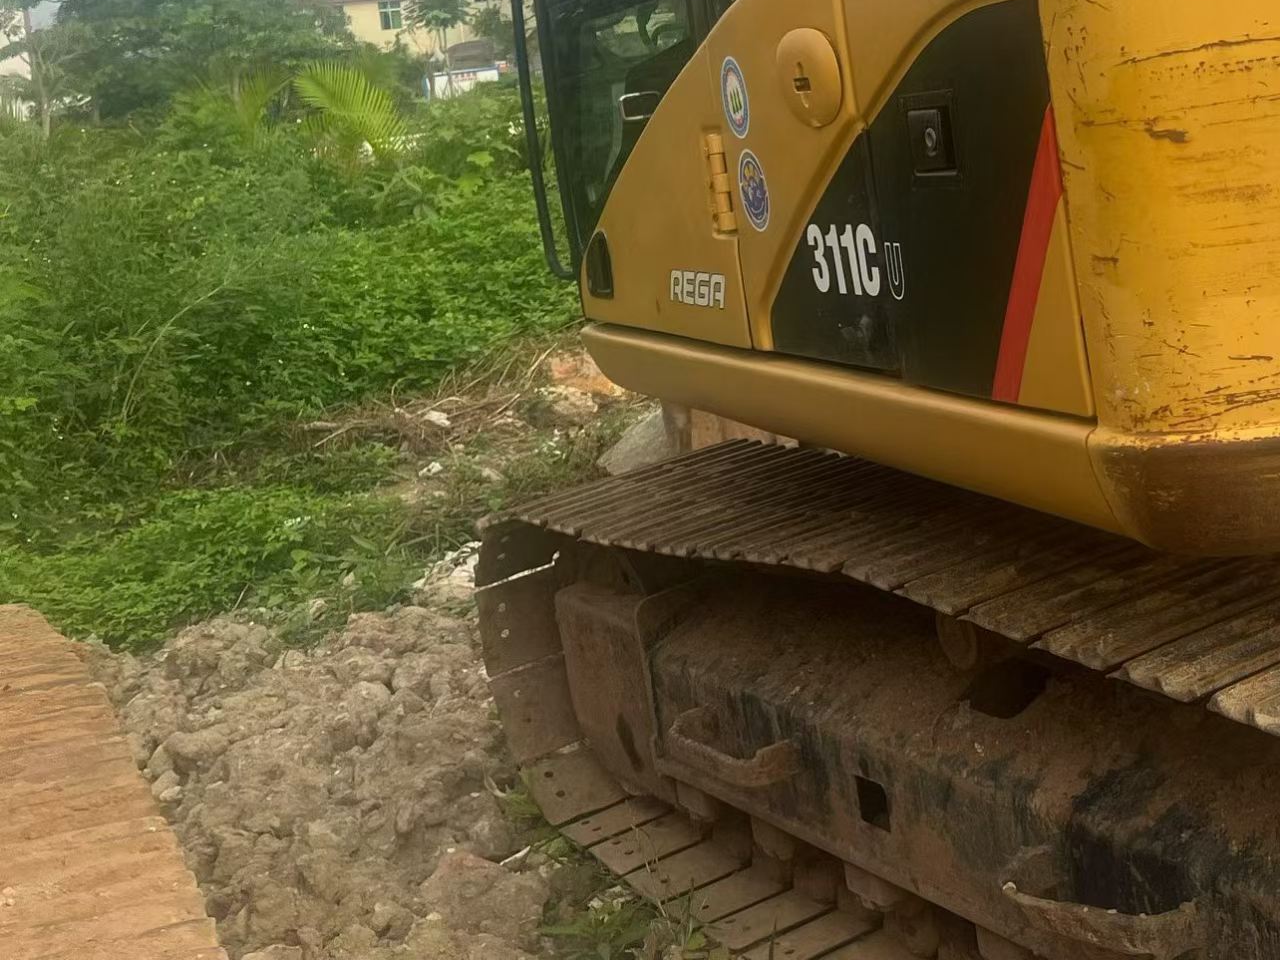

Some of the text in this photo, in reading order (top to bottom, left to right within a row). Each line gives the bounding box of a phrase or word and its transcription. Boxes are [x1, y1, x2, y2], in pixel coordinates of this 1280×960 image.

[669, 269, 726, 309] REGA
[806, 223, 905, 301] 311C U
